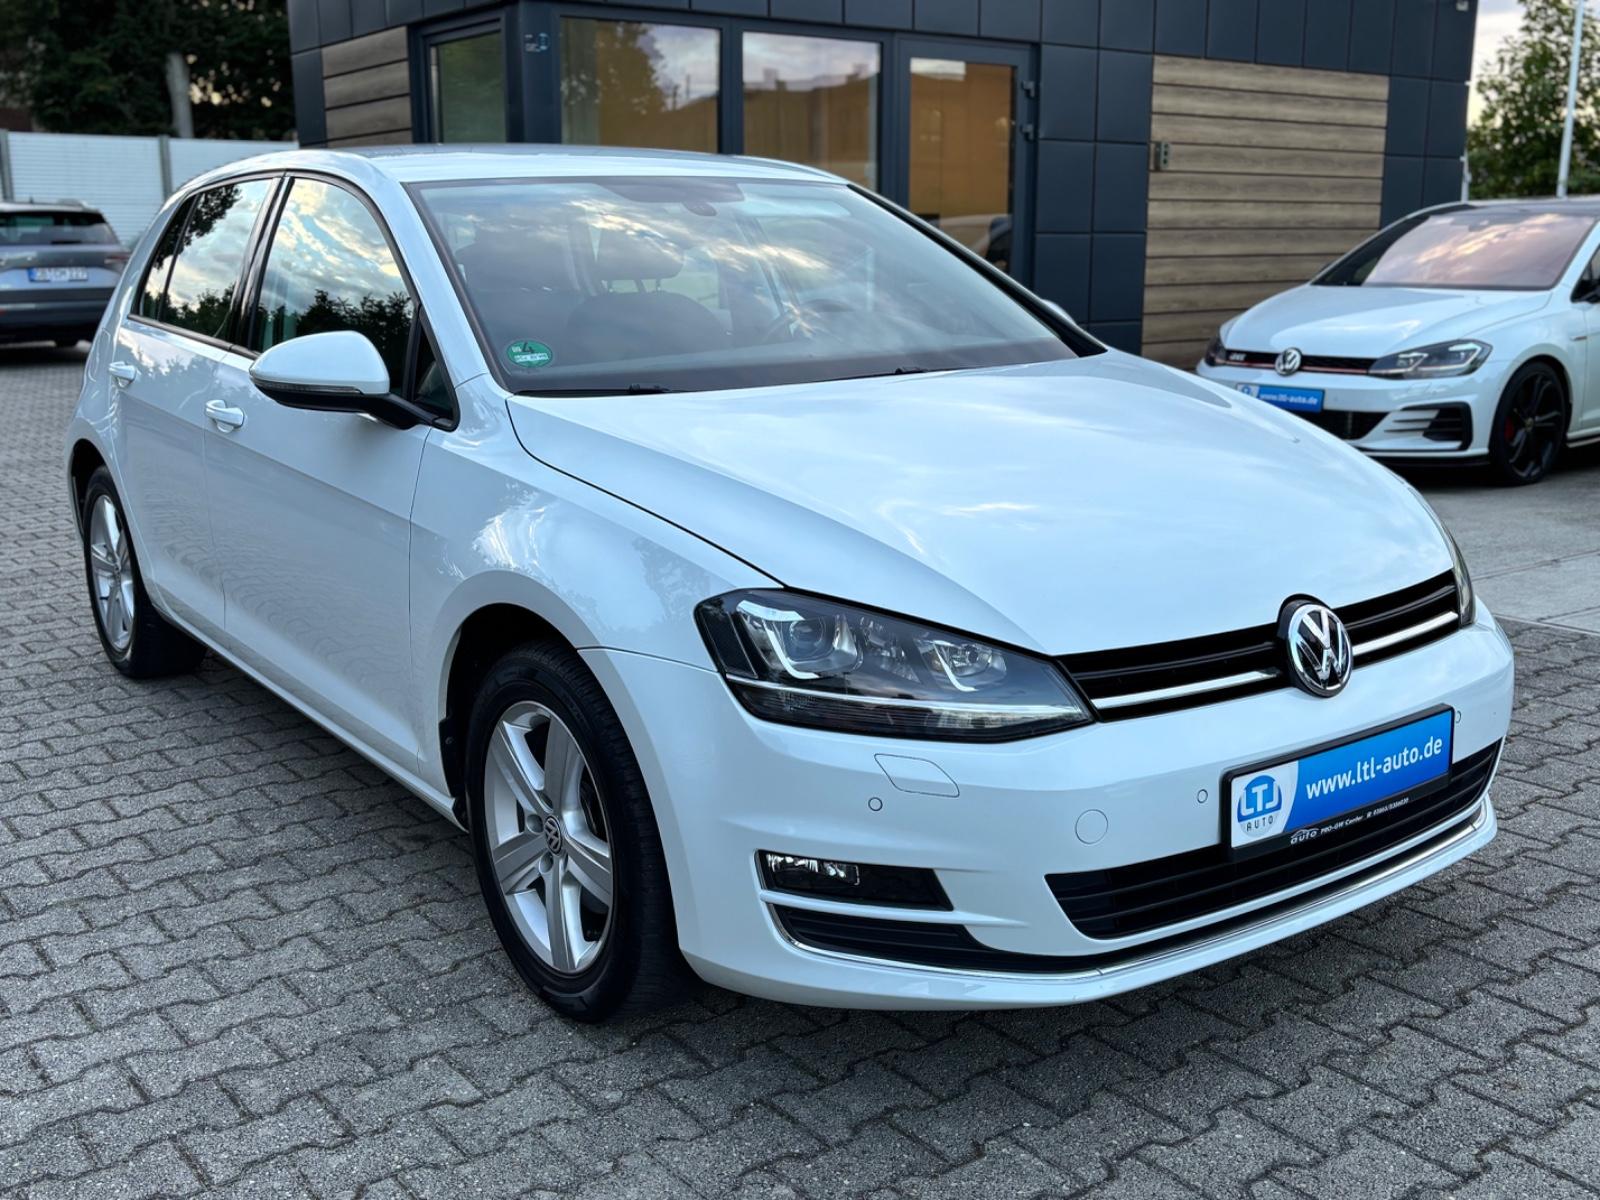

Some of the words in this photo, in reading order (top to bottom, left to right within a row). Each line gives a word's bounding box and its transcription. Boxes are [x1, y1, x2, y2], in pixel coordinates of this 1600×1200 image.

[522, 341, 534, 353] 4
[1288, 604, 1351, 690] VW
[1306, 735, 1443, 800] www.ltl-auto.de
[1246, 815, 1274, 832] AUTO
